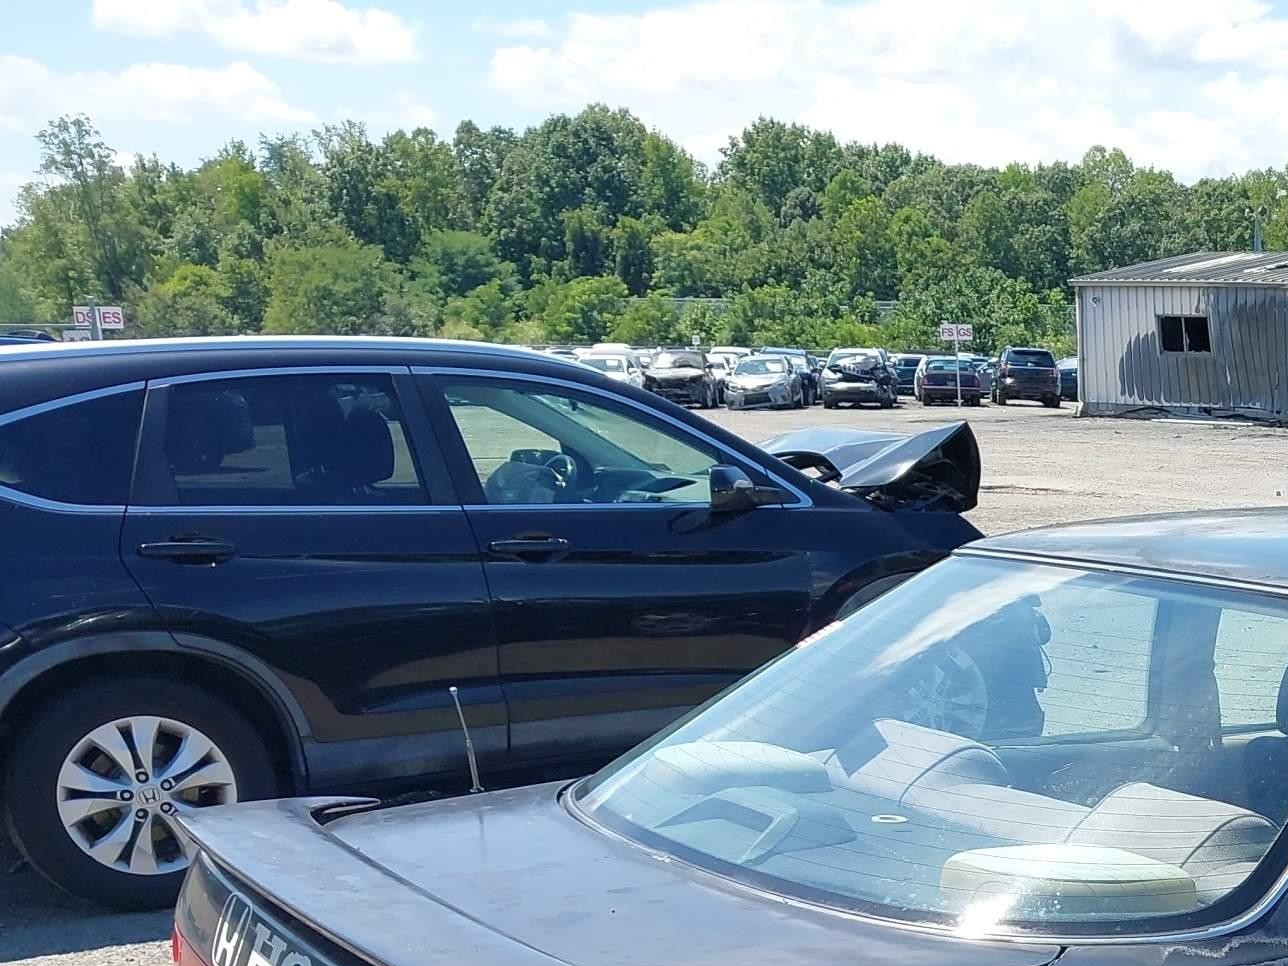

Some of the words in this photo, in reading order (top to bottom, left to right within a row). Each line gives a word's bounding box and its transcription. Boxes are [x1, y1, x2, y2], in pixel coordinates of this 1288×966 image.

[102, 311, 122, 324] ES
[941, 327, 954, 337] FS
[958, 327, 972, 337] GS
